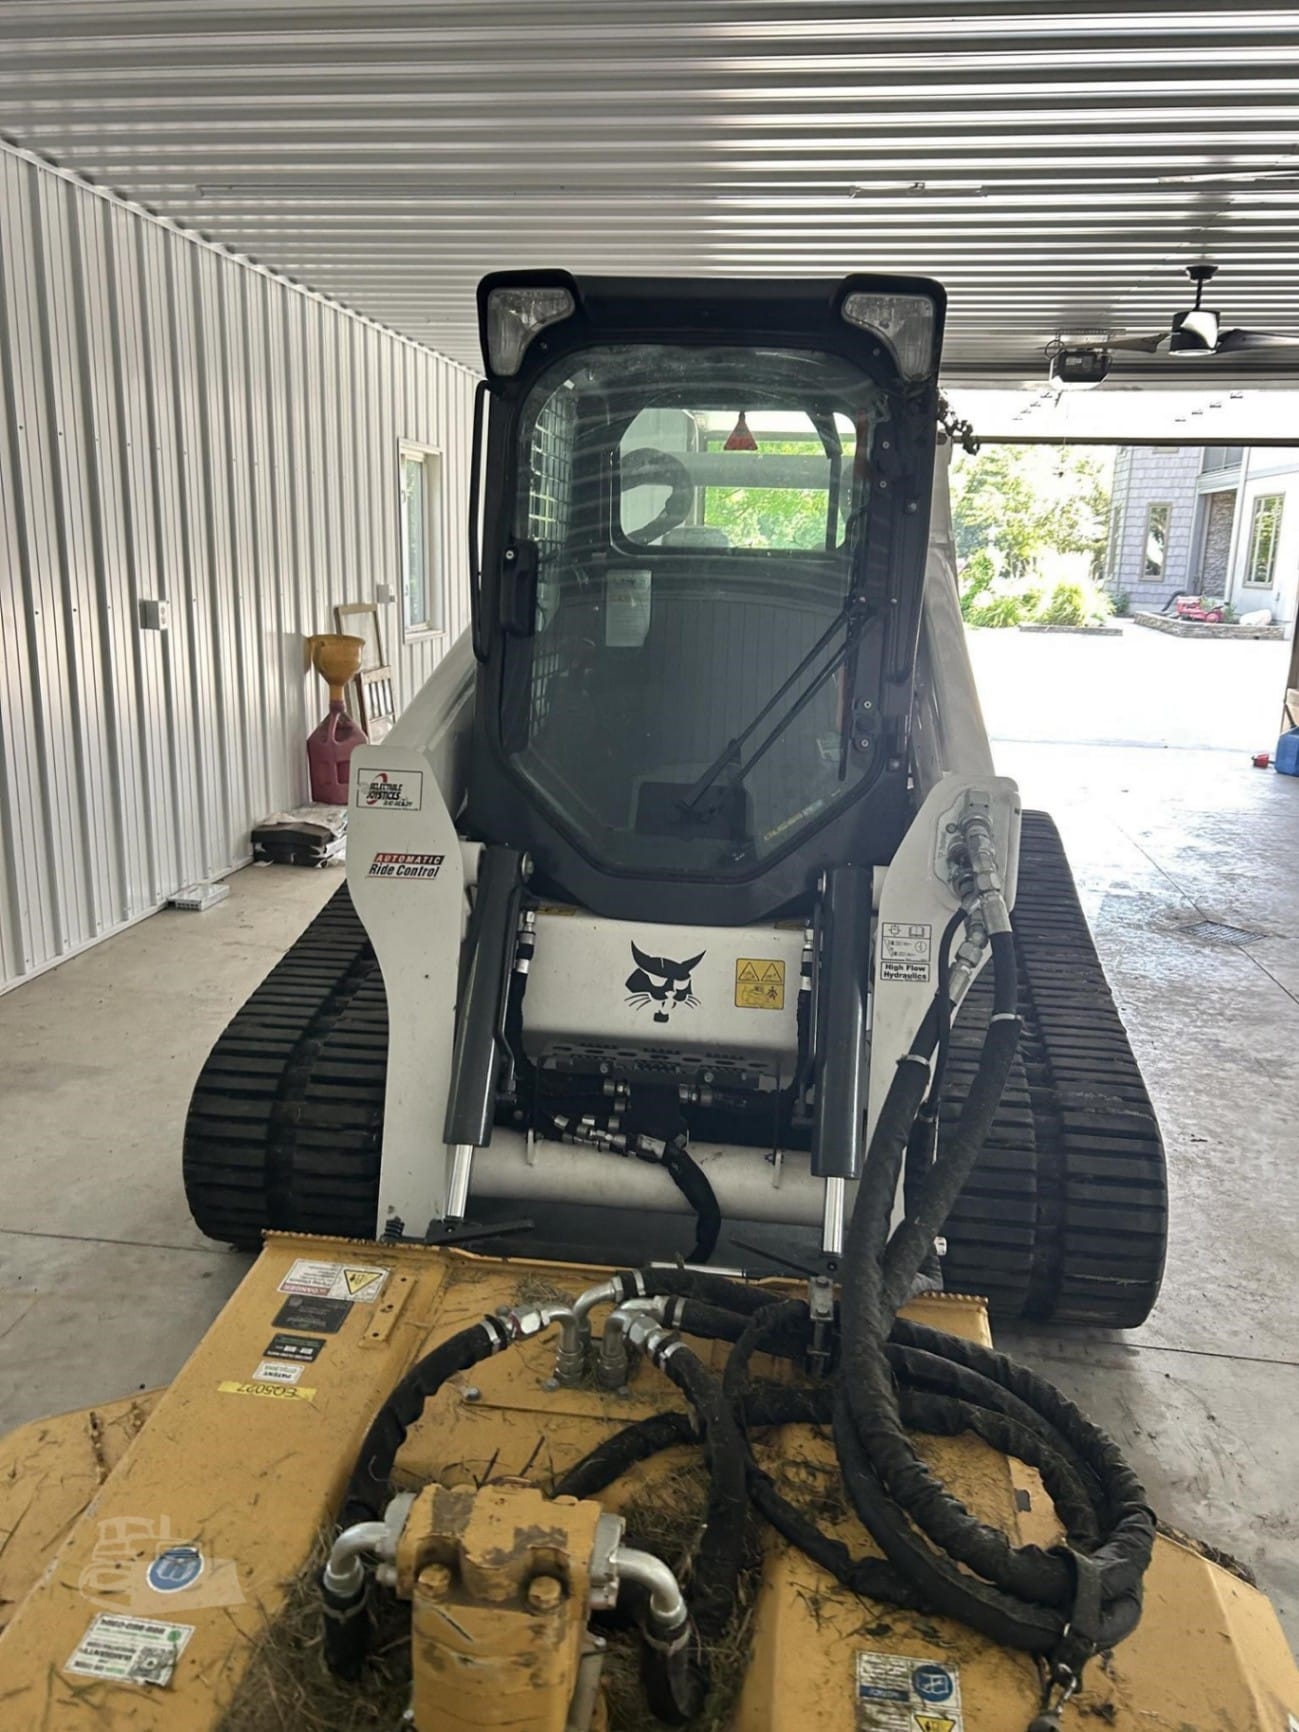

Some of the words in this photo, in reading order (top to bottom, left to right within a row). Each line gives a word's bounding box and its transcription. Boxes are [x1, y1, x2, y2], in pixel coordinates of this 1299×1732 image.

[376, 854, 442, 864] AUTOMATIC
[368, 863, 395, 876] Ride
[396, 864, 440, 877] Control
[883, 971, 926, 979] Hydraulics
[263, 1371, 292, 1379] PATENT
[237, 1384, 298, 1397] EQ5027
